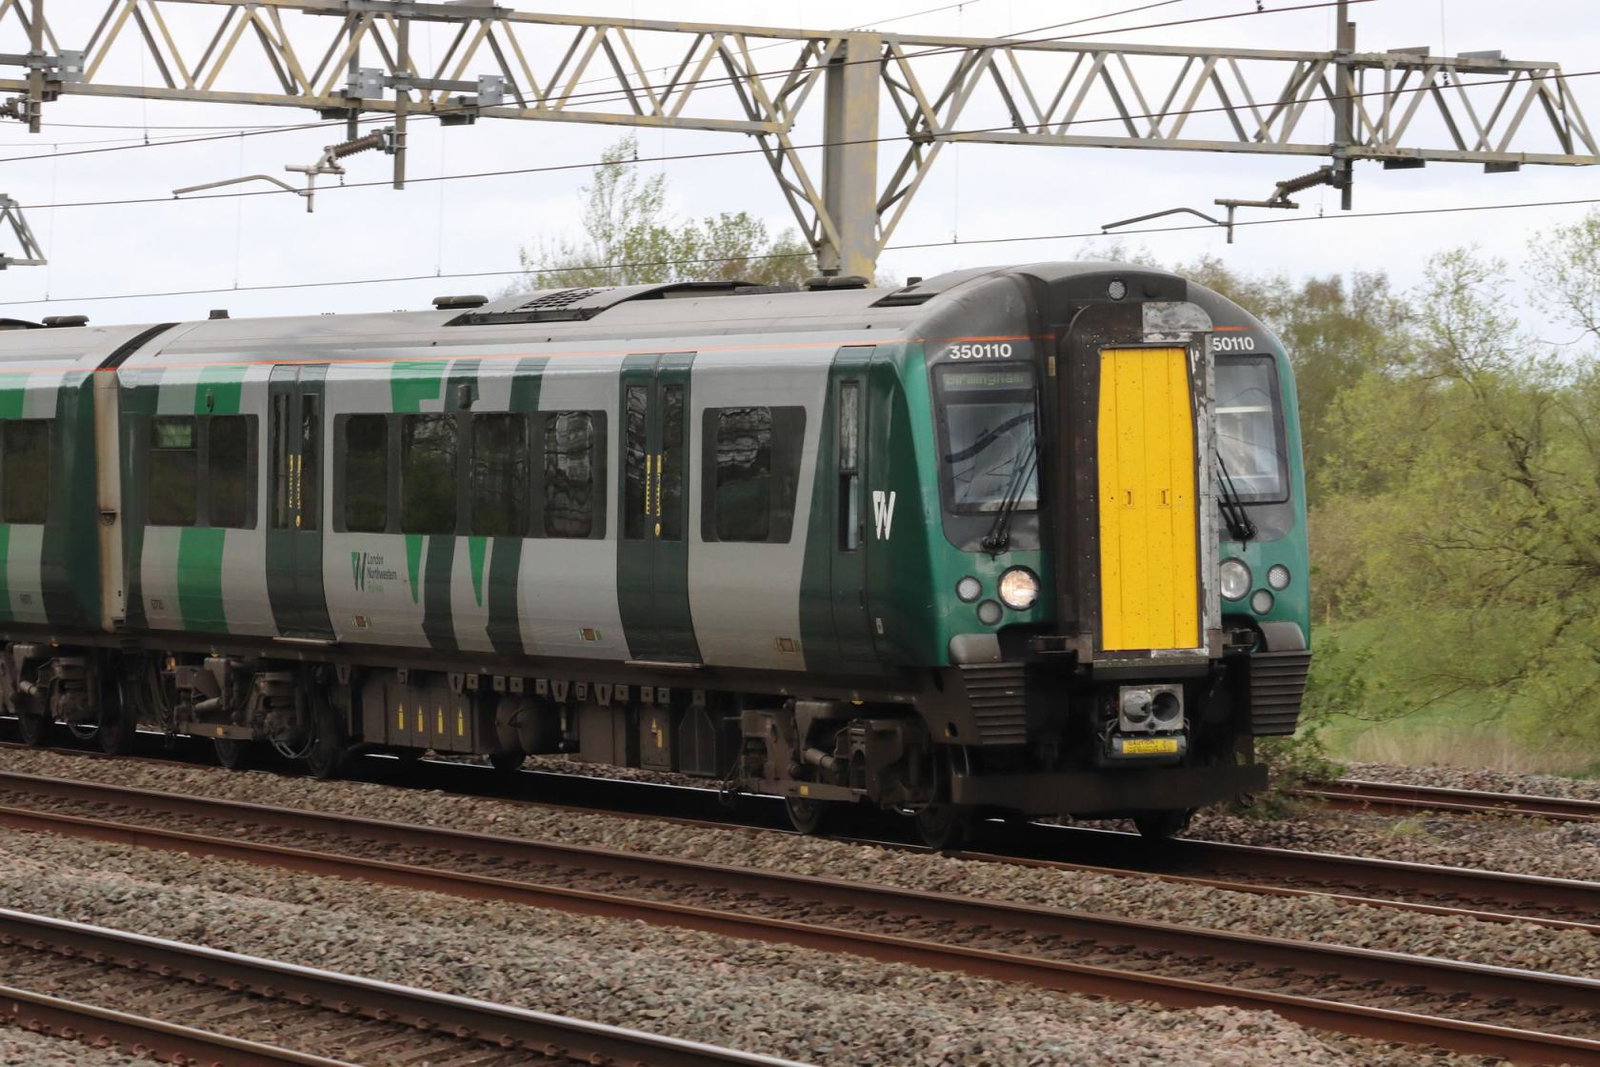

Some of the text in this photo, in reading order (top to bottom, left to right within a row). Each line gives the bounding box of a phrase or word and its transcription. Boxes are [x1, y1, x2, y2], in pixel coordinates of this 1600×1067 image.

[949, 343, 1012, 359] 350110
[367, 552, 384, 565] London
[367, 567, 398, 580] Northwestern
